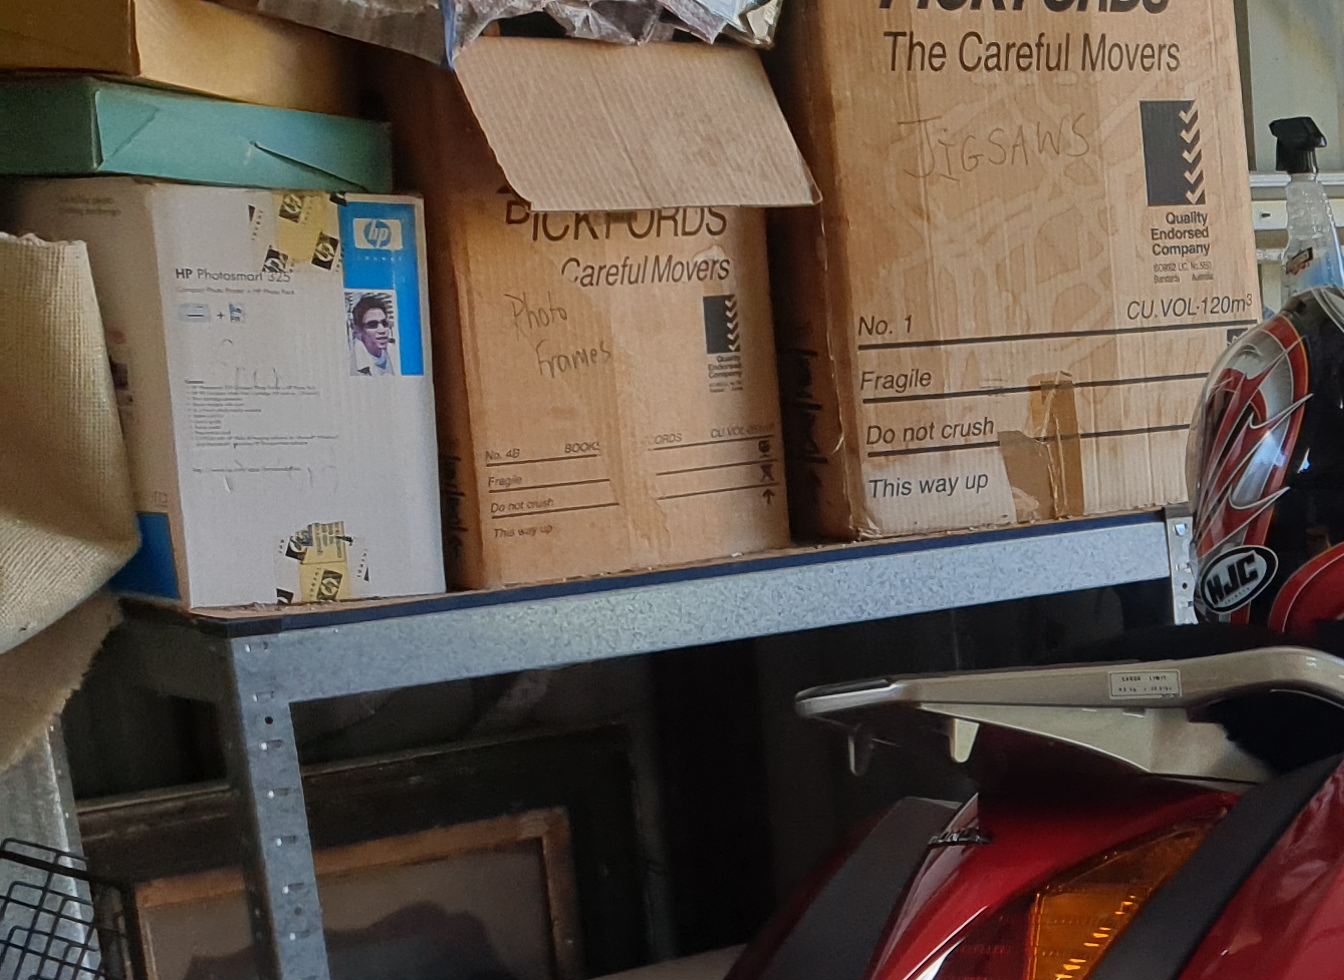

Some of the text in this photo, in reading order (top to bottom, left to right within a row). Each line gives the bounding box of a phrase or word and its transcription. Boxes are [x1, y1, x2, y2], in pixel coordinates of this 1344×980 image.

[884, 31, 1180, 72] The Careful Movers
[1166, 211, 1208, 226] Quality
[1151, 226, 1209, 241] Endorsed
[1152, 243, 1211, 257] Company
[175, 268, 291, 283] HP Photosmart 325
[561, 254, 731, 287] Careful Movers
[858, 315, 912, 336] No. 1
[860, 369, 932, 393] Fragile
[866, 417, 995, 445] Do not crush
[868, 473, 989, 499] This way up
[490, 502, 505, 513] Do
[508, 501, 524, 511] not
[494, 528, 516, 539] This
[1206, 553, 1259, 605] HJC
